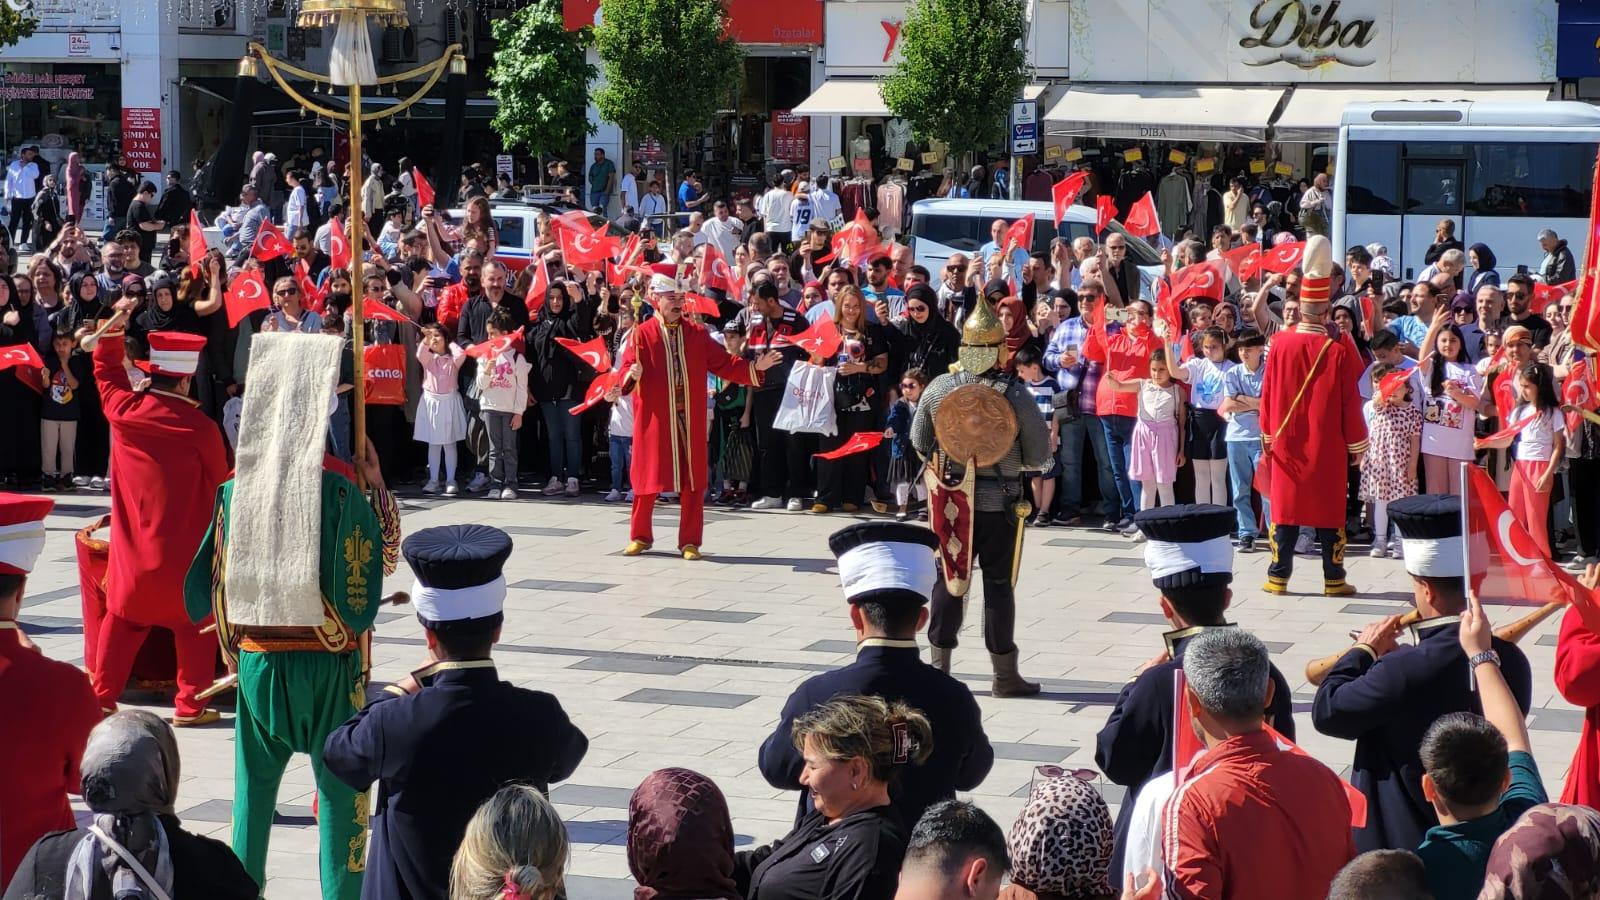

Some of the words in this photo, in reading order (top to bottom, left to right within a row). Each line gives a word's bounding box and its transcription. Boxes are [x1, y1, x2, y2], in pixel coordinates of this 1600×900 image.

[1239, 0, 1376, 48] Diba
[149, 131, 160, 139] AL
[1140, 127, 1167, 137] DIBA
[139, 141, 150, 149] AY
[126, 151, 157, 159] SONRA
[132, 160, 152, 169] ÖDE
[796, 209, 811, 225] 19
